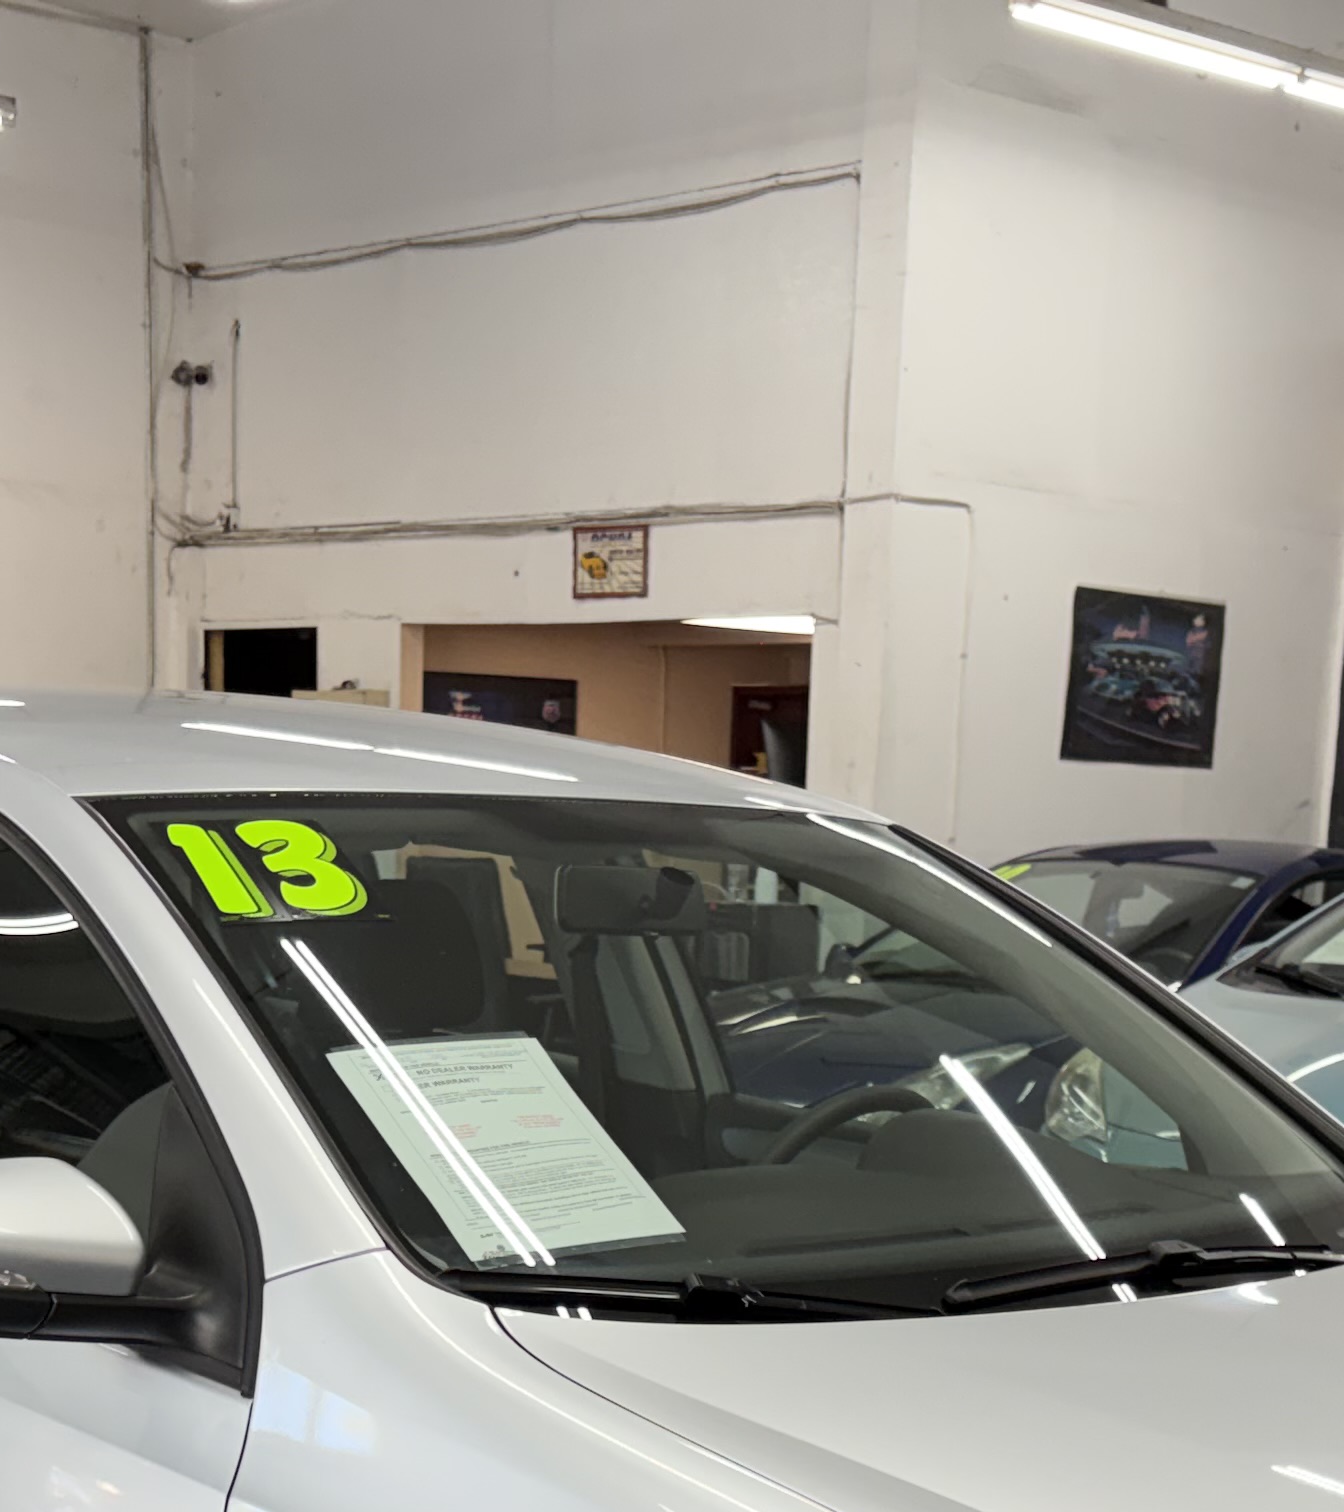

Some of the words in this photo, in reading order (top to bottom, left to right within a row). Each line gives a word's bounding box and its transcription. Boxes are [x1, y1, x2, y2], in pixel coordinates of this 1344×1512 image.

[166, 819, 369, 919] 13
[431, 1065, 466, 1074] DEALER
[466, 1063, 513, 1071] WARRANTY
[432, 1076, 480, 1087] WARRANTY
